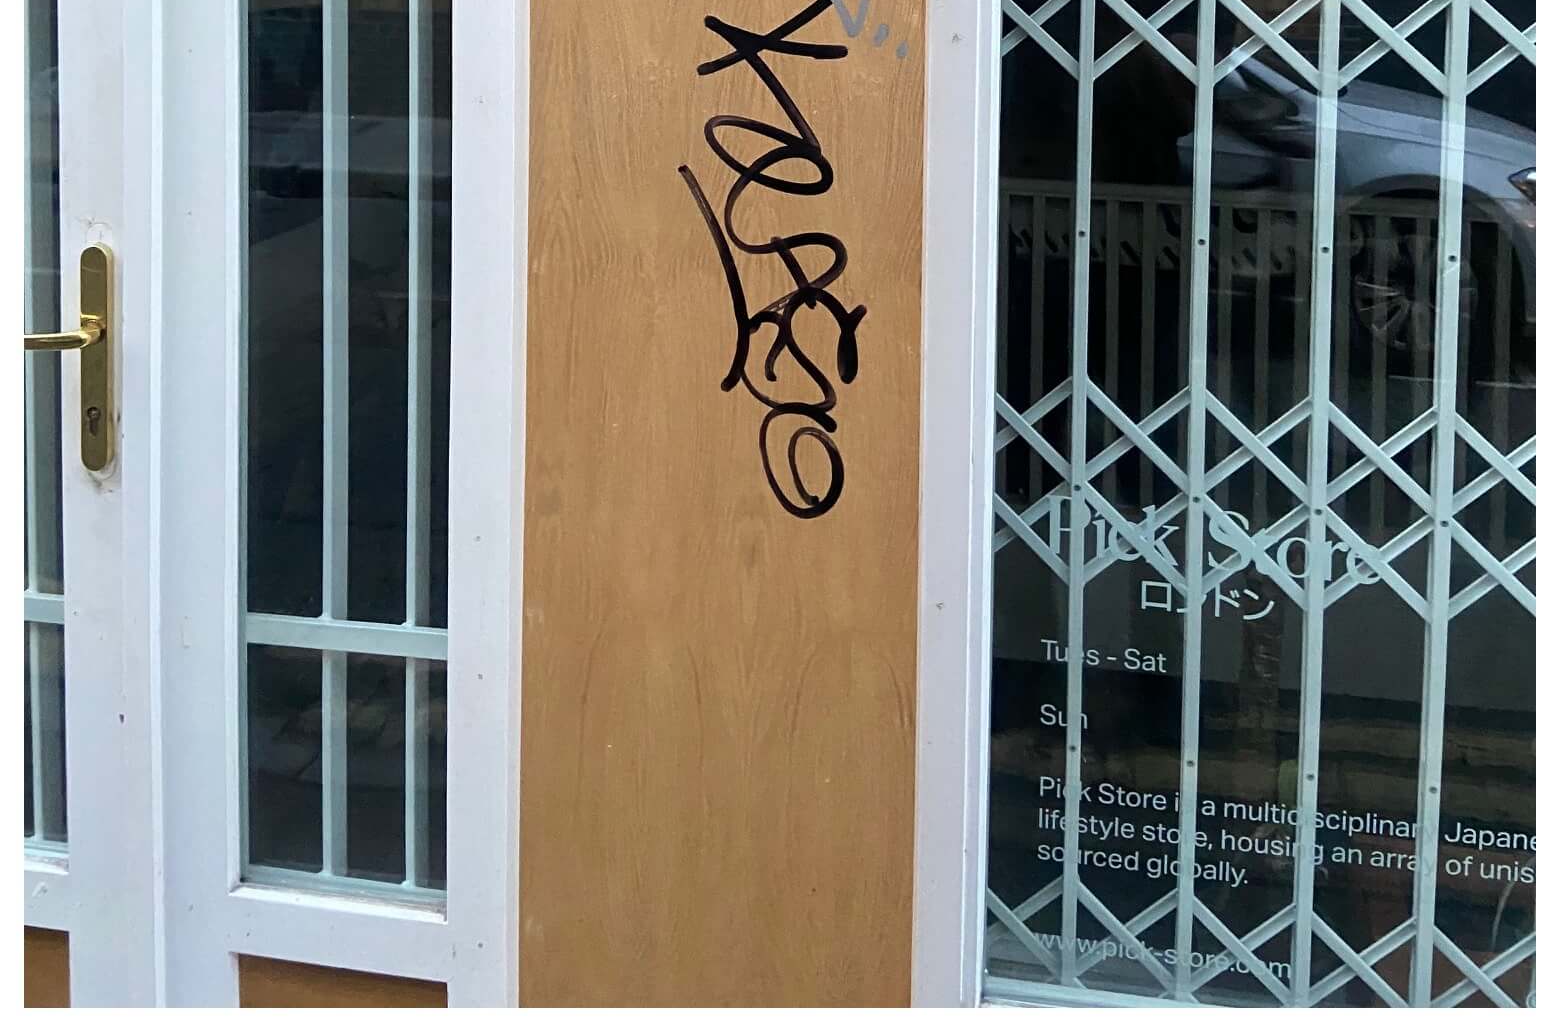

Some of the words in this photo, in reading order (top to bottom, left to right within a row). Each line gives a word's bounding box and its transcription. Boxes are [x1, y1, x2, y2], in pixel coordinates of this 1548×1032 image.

[1048, 495, 1179, 567] Pick
[1208, 509, 1384, 585] Store
[1141, 580, 1275, 620] ロドン
[1040, 638, 1100, 666] Tus
[1123, 648, 1167, 673] Sat
[1040, 703, 1088, 729] Sun
[1098, 783, 1167, 811] Store
[1201, 799, 1216, 817] a
[1224, 801, 1434, 842] multisciplinar
[1038, 807, 1135, 841] lifestyle
[1142, 822, 1213, 851] stoe,
[1221, 829, 1324, 866] housig
[1330, 845, 1363, 865] an
[1370, 849, 1434, 877] arra
[1445, 855, 1474, 877] of
[1034, 932, 1292, 979] www.pick-sore.cm
